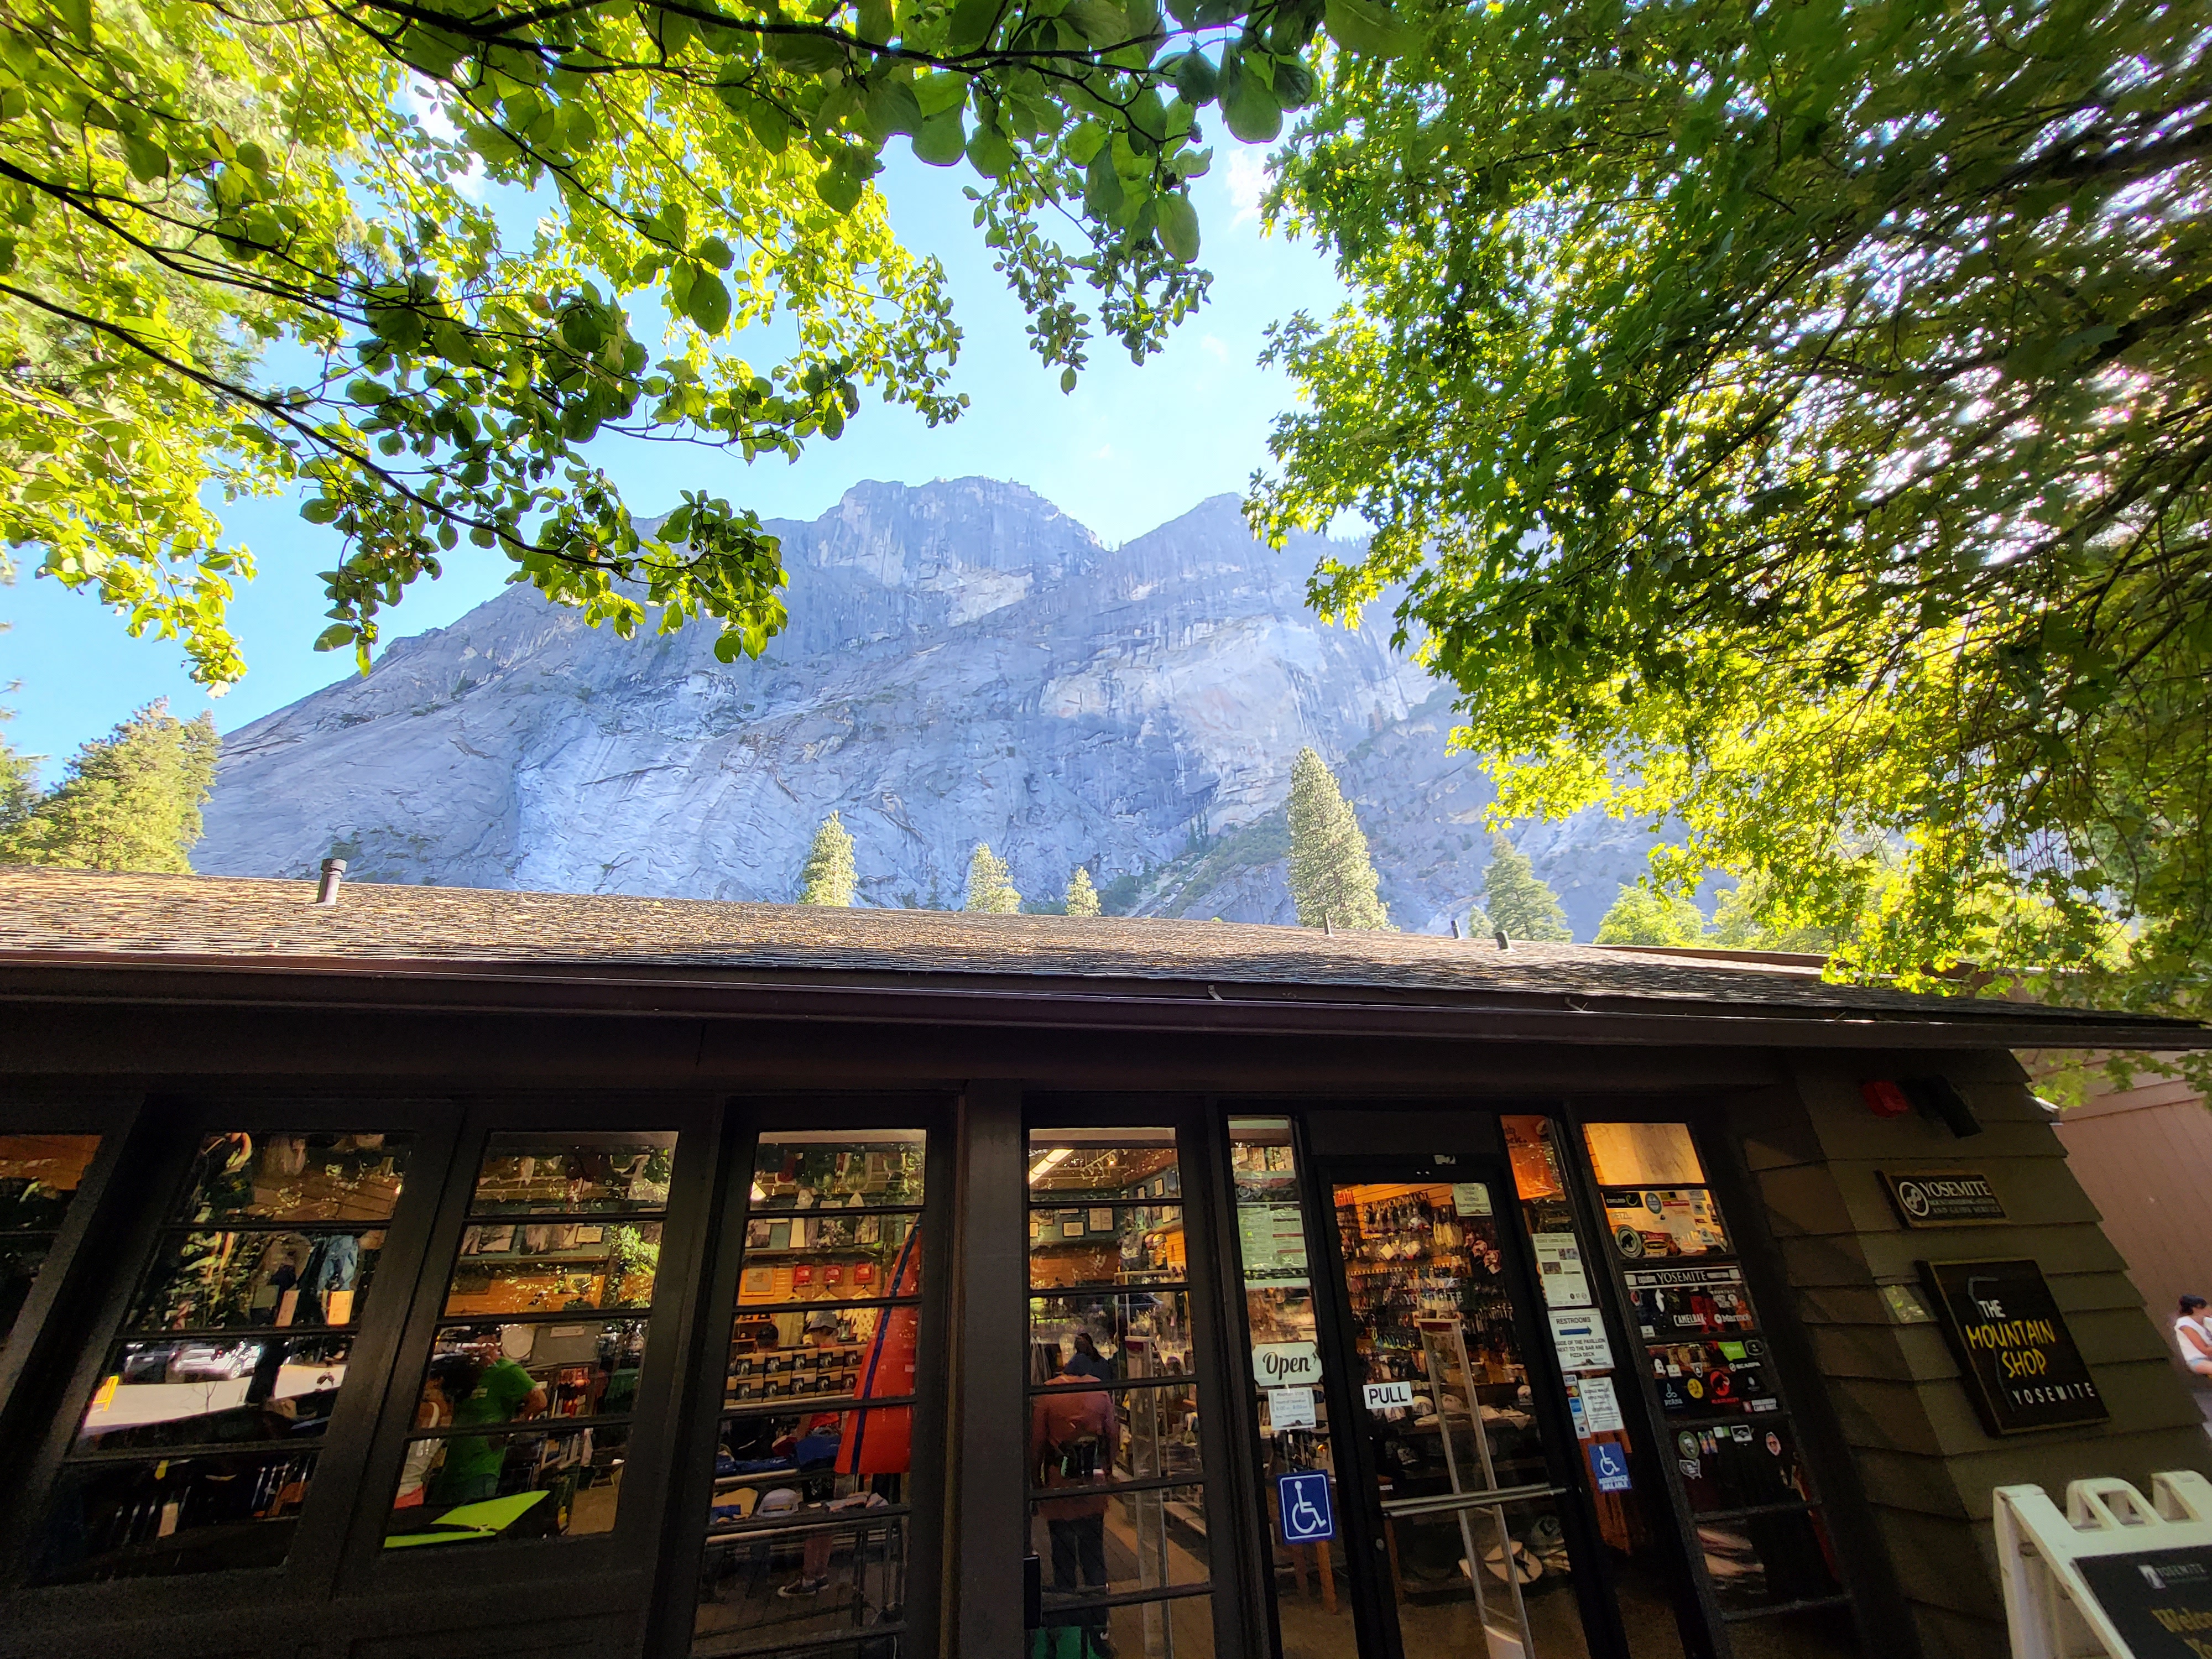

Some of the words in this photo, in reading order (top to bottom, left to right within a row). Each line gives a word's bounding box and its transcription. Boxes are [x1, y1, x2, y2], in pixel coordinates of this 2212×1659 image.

[1919, 1181, 1992, 1197] YOSEMITE
[1656, 1271, 1707, 1285] YOSEMITE
[1978, 1300, 2006, 1318] THE
[1965, 1318, 2056, 1350] MOUNTAIN
[1262, 1352, 1311, 1381] Open
[2001, 1348, 2046, 1378] SHOP
[1368, 1386, 1408, 1405] PULL
[2012, 1383, 2095, 1405] YOSEMITE
